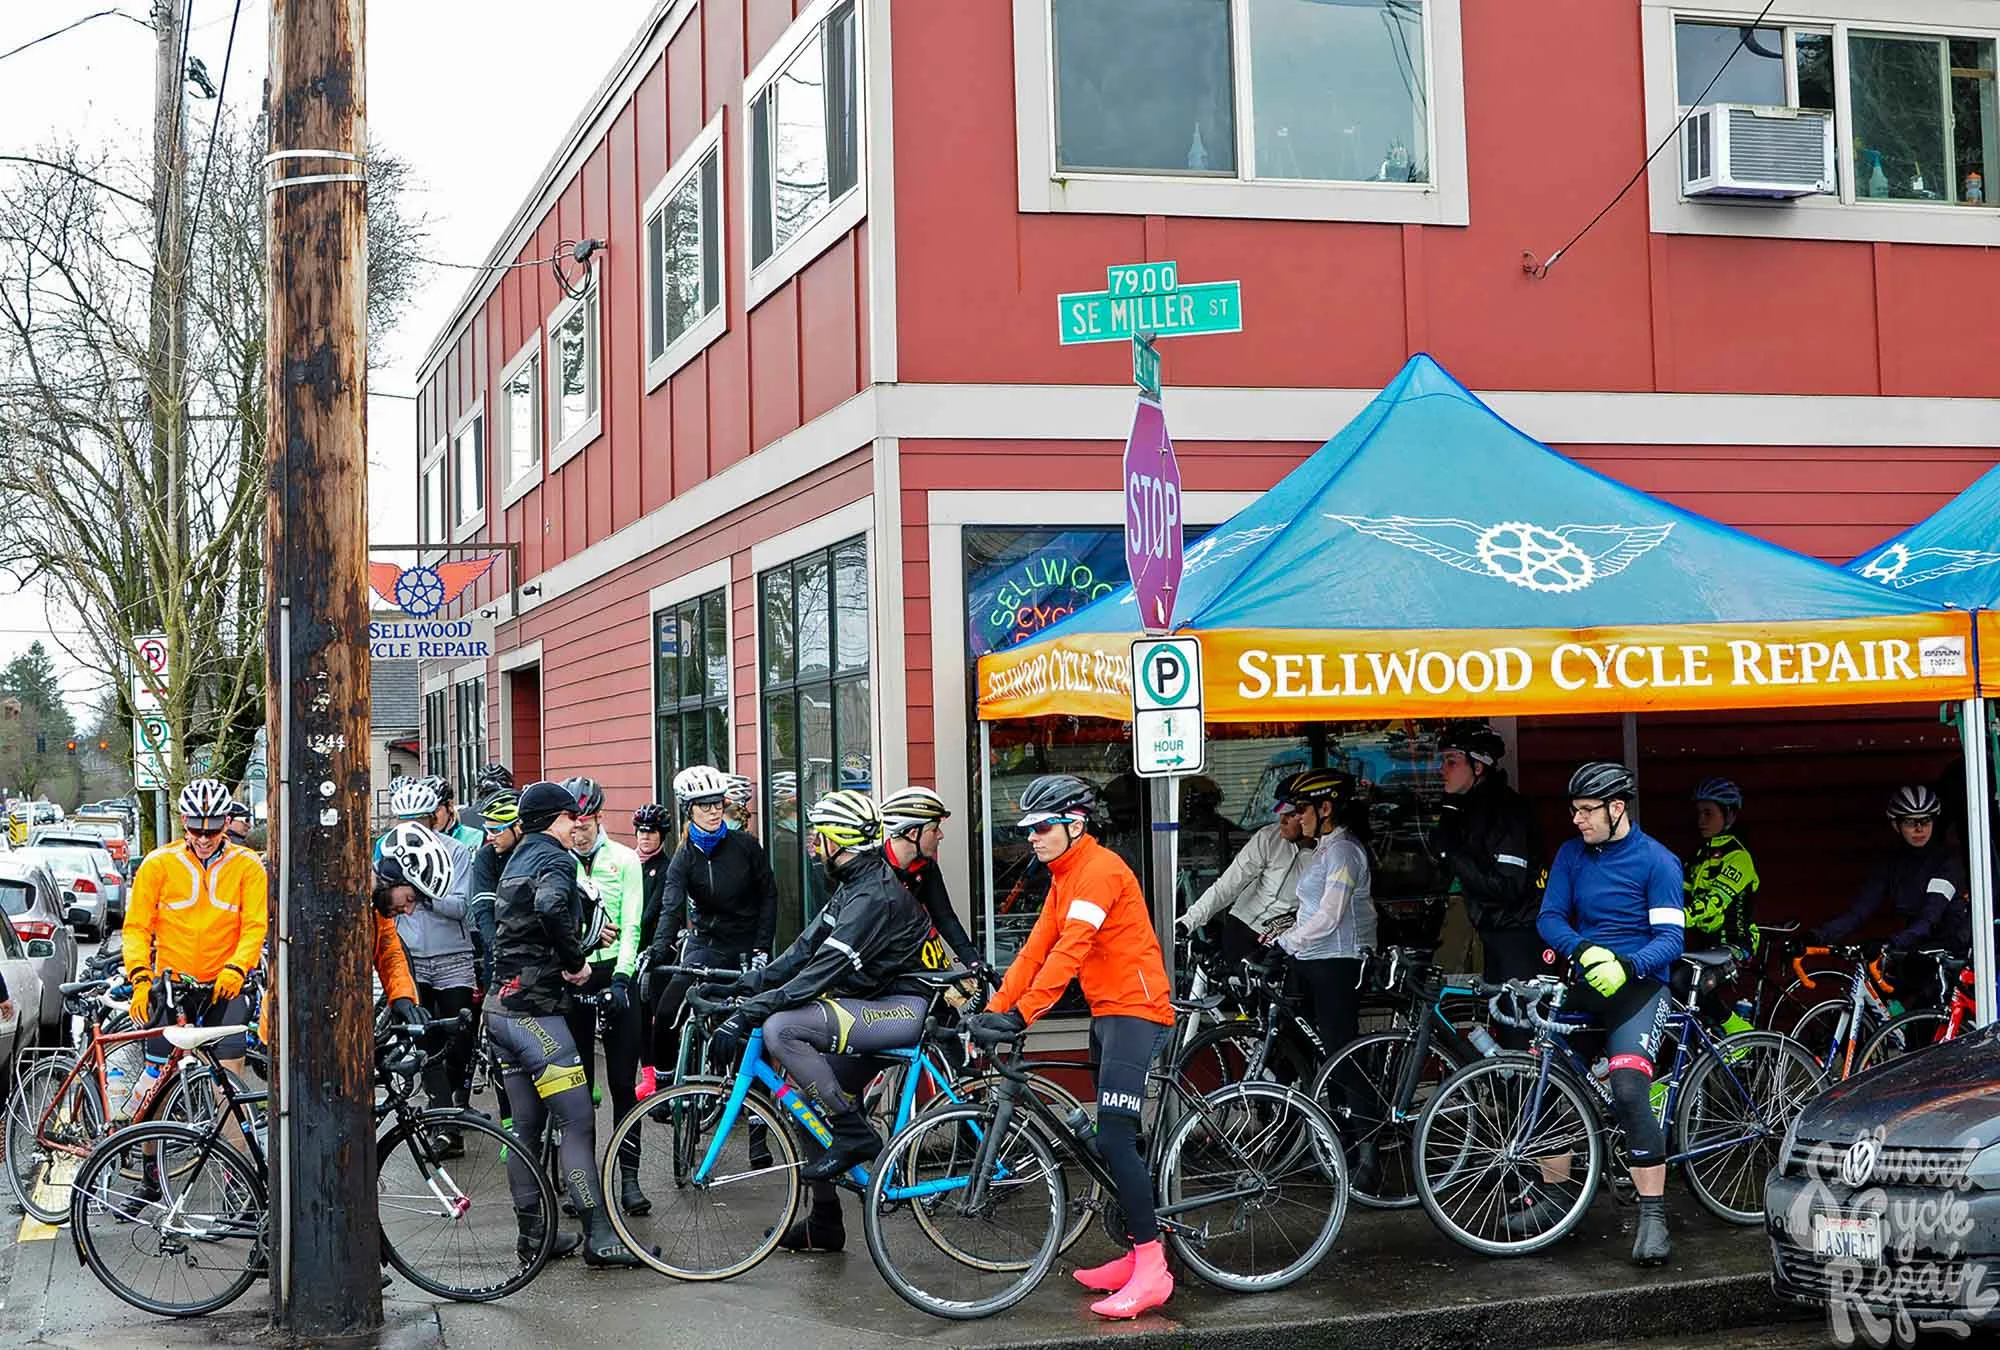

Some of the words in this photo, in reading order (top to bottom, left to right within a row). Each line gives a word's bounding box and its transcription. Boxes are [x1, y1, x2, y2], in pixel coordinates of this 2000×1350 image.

[1111, 266, 1174, 294] 7900
[1072, 302, 1101, 335] SE
[1111, 294, 1195, 332] MILLER
[1209, 299, 1229, 317] ST
[1130, 472, 1177, 560] STOP
[990, 557, 1112, 629] SELLWO
[368, 621, 472, 639] SELLWOOD
[370, 643, 411, 658] YCLE
[418, 641, 489, 657] REPAIR
[1049, 648, 1092, 692] CYCLE
[1156, 657, 1179, 693] P
[1238, 647, 1532, 699] SELLWOOD
[1551, 643, 1713, 691] CYCLE
[1727, 639, 1920, 686] REPAIR
[1164, 717, 1172, 737] 1
[1154, 740, 1184, 753] HOUR
[862, 1005, 917, 1028] OLYMPIA
[1102, 1091, 1140, 1112] RAPHA
